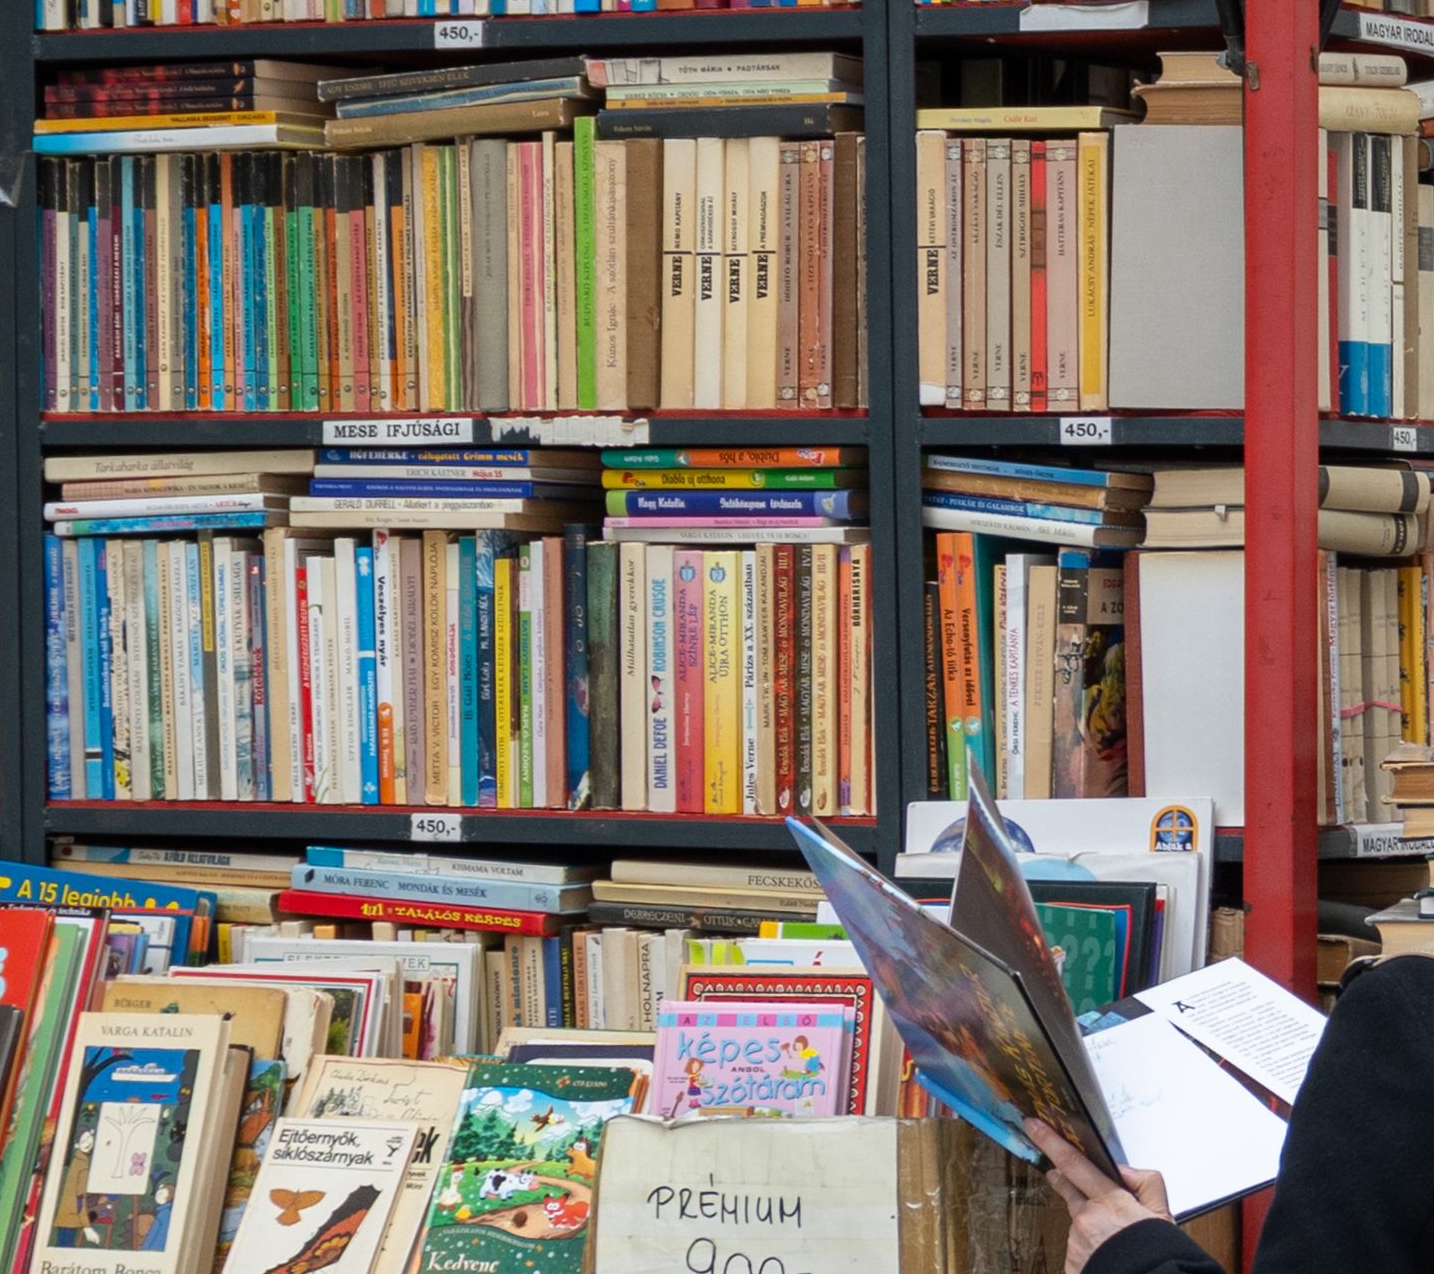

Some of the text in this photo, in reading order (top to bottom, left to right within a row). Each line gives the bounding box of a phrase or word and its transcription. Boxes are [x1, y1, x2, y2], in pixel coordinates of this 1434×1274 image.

[439, 26, 479, 41] 450,-
[1365, 22, 1402, 41] MAGYAR
[1087, 235, 1095, 273] ANDRÁS
[672, 256, 682, 296] VERNE
[701, 257, 712, 300] VERNE
[729, 259, 740, 303] VERNE
[757, 254, 768, 299] VERNE
[927, 249, 938, 295] VERNE
[334, 421, 460, 438] MESE IFJÚSÁGI
[1064, 422, 1109, 439] 450,-
[1394, 432, 1416, 445] 450,-
[744, 564, 754, 620] században
[652, 578, 666, 789] DANIEL DEFOE ROBINSON CRUSOE
[744, 655, 754, 689] Párizs
[746, 738, 755, 770] Verne
[746, 773, 756, 802] Jules
[416, 819, 456, 835] 450,-
[17, 879, 32, 898] A
[40, 882, 56, 902] 15
[323, 873, 488, 898] MÓRA FERENC MONDÁK ÉS MESÉK
[394, 906, 521, 928] TALÁLÓS KÉRDÉS
[101, 1026, 194, 1038] VARGA KATALIN
[678, 1031, 782, 1068] képes
[702, 1075, 826, 1107] szótáram
[278, 1129, 360, 1149] Ejtőernyők,
[272, 1146, 375, 1166] siklószárnyak
[427, 1252, 499, 1273] Kedvenc
